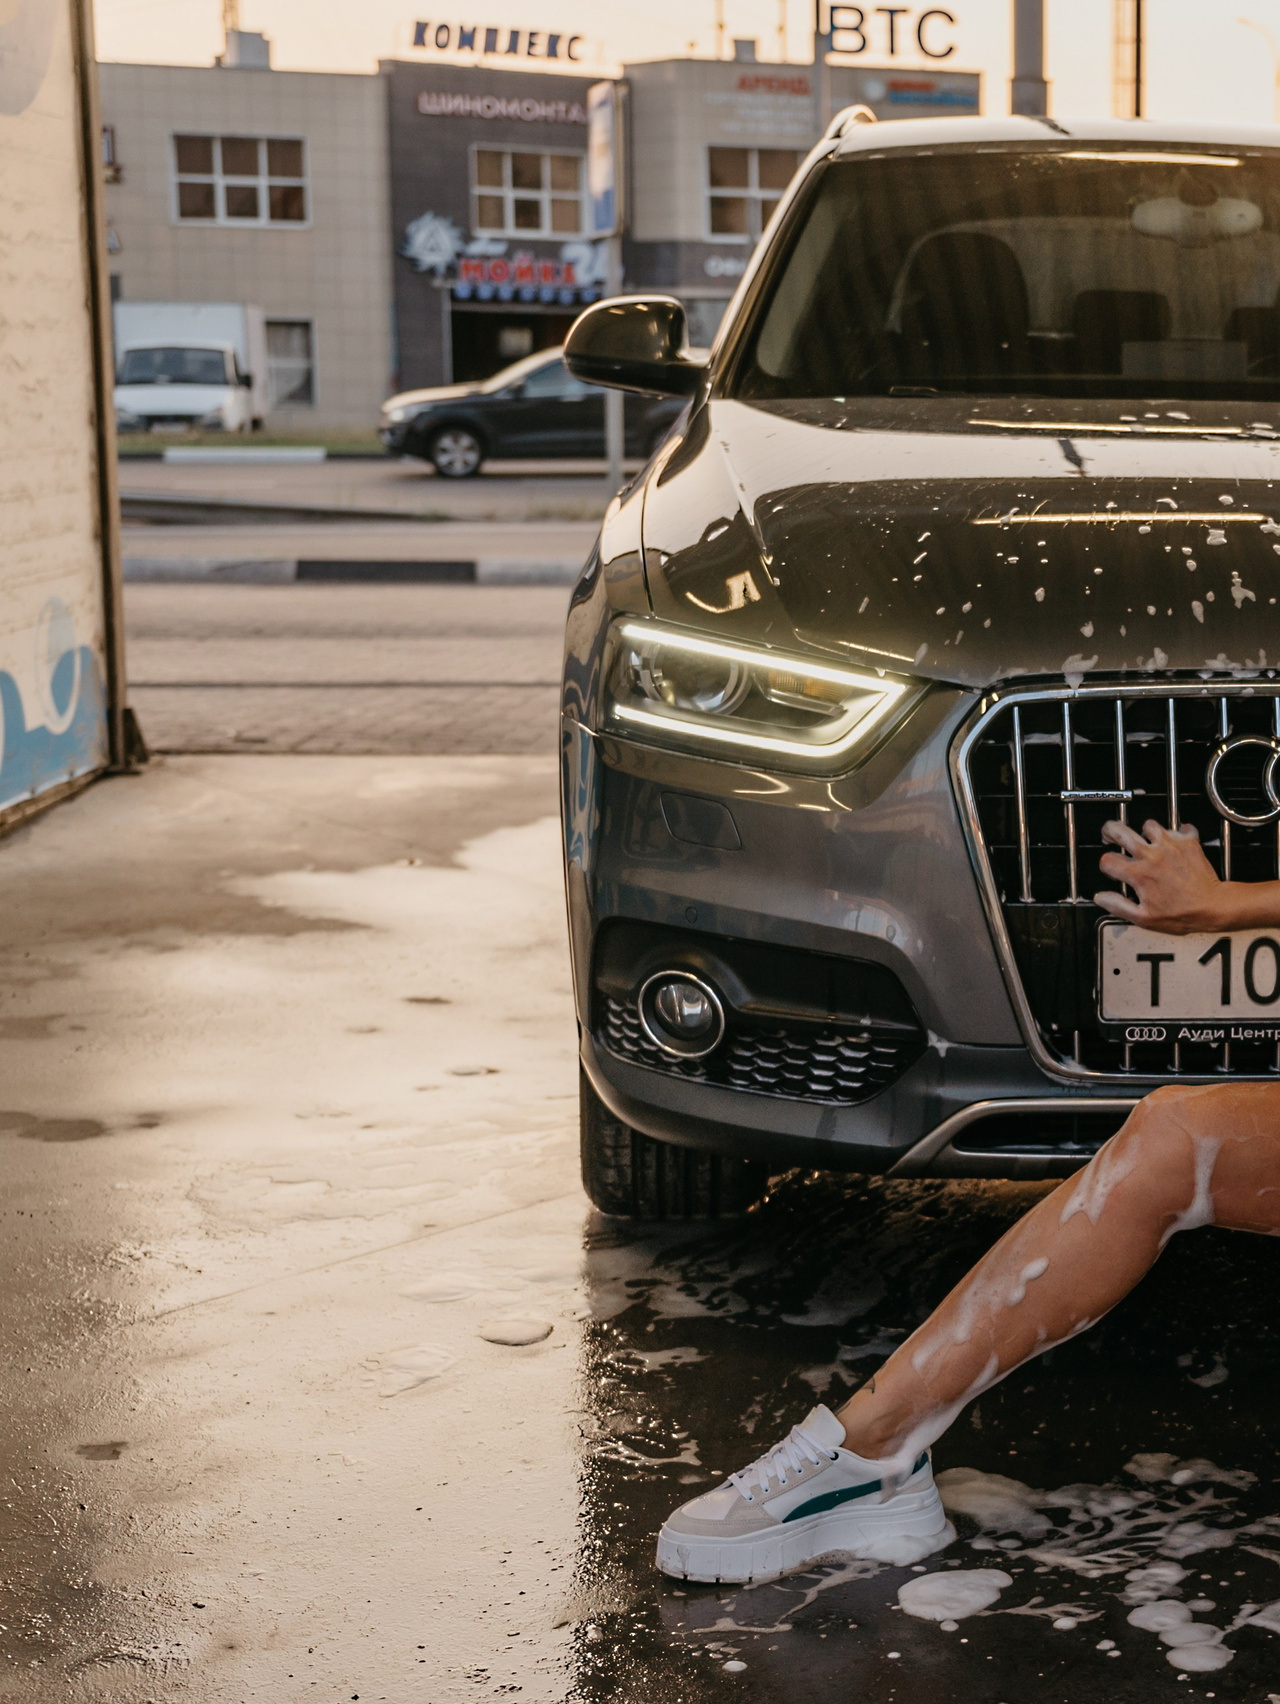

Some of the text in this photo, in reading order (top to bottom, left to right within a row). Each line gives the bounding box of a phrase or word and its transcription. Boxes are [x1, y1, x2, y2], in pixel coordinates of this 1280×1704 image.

[413, 22, 582, 61] КОМПЛЕКС
[830, 6, 954, 58] ВТС
[737, 75, 812, 96] АРЕНД
[417, 91, 588, 125] ШИНОМОНТА
[460, 252, 577, 286] МОЙКА
[1066, 791, 1125, 800] quattro
[1178, 1027, 1225, 1041] Ауди
